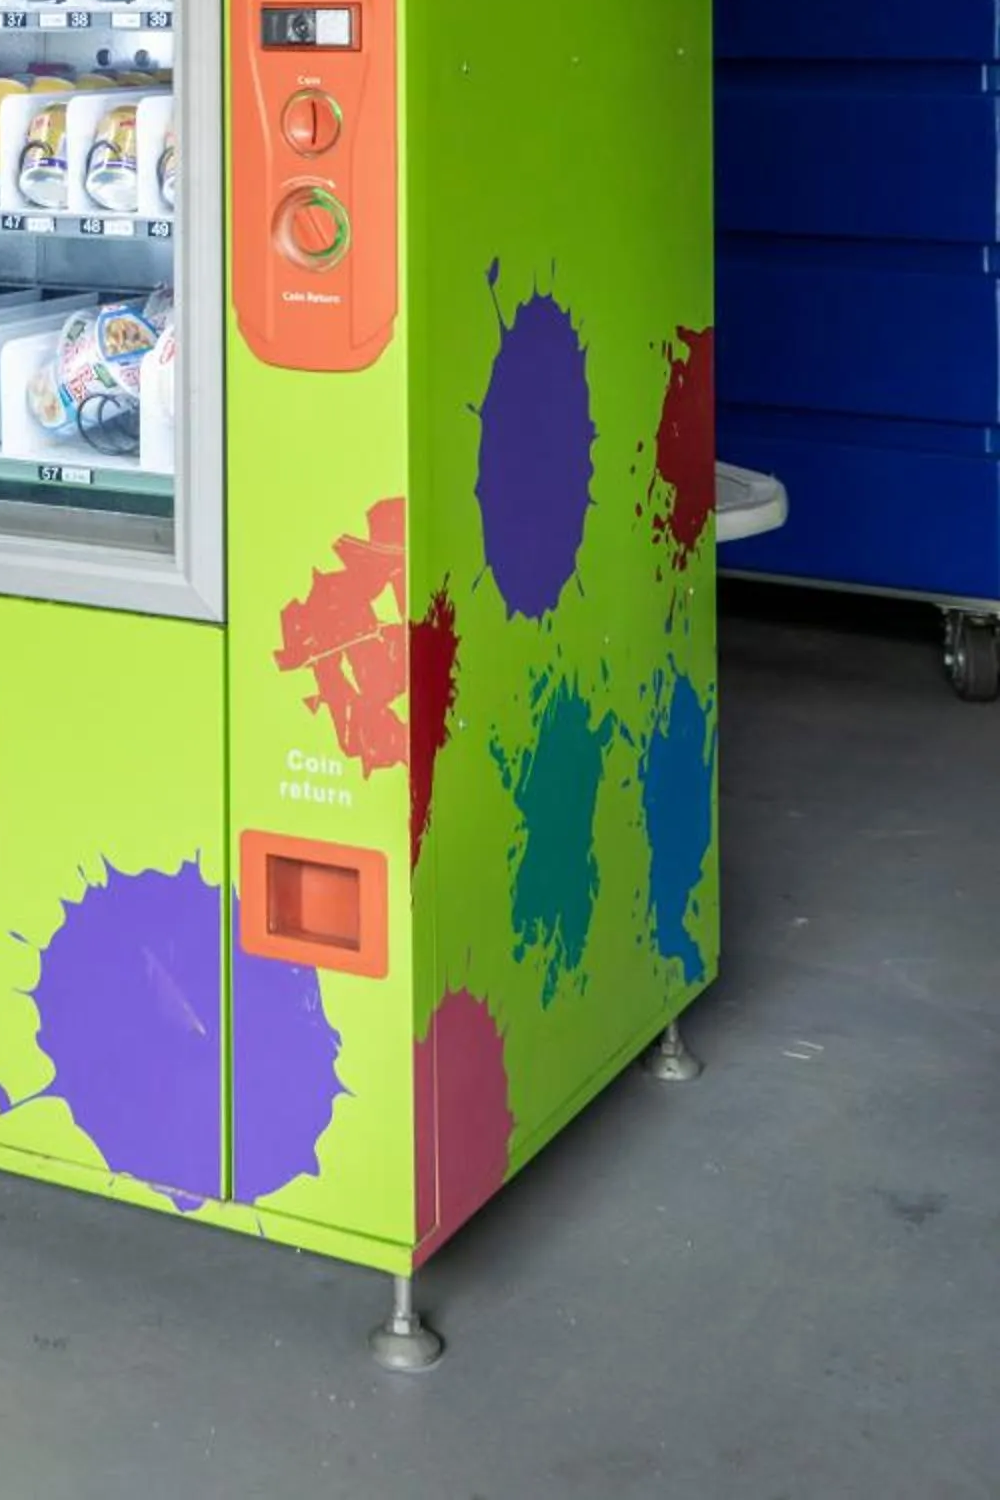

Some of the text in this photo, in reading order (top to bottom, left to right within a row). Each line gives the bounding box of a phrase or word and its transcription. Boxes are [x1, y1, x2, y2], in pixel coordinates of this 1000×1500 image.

[7, 13, 23, 26] 37
[71, 13, 87, 26] 38
[151, 13, 167, 26] 39
[4, 216, 21, 228] 47
[83, 219, 100, 232] 48
[151, 223, 168, 236] 49
[42, 467, 59, 480] 57
[286, 747, 343, 776] Coin
[279, 780, 352, 808] return
